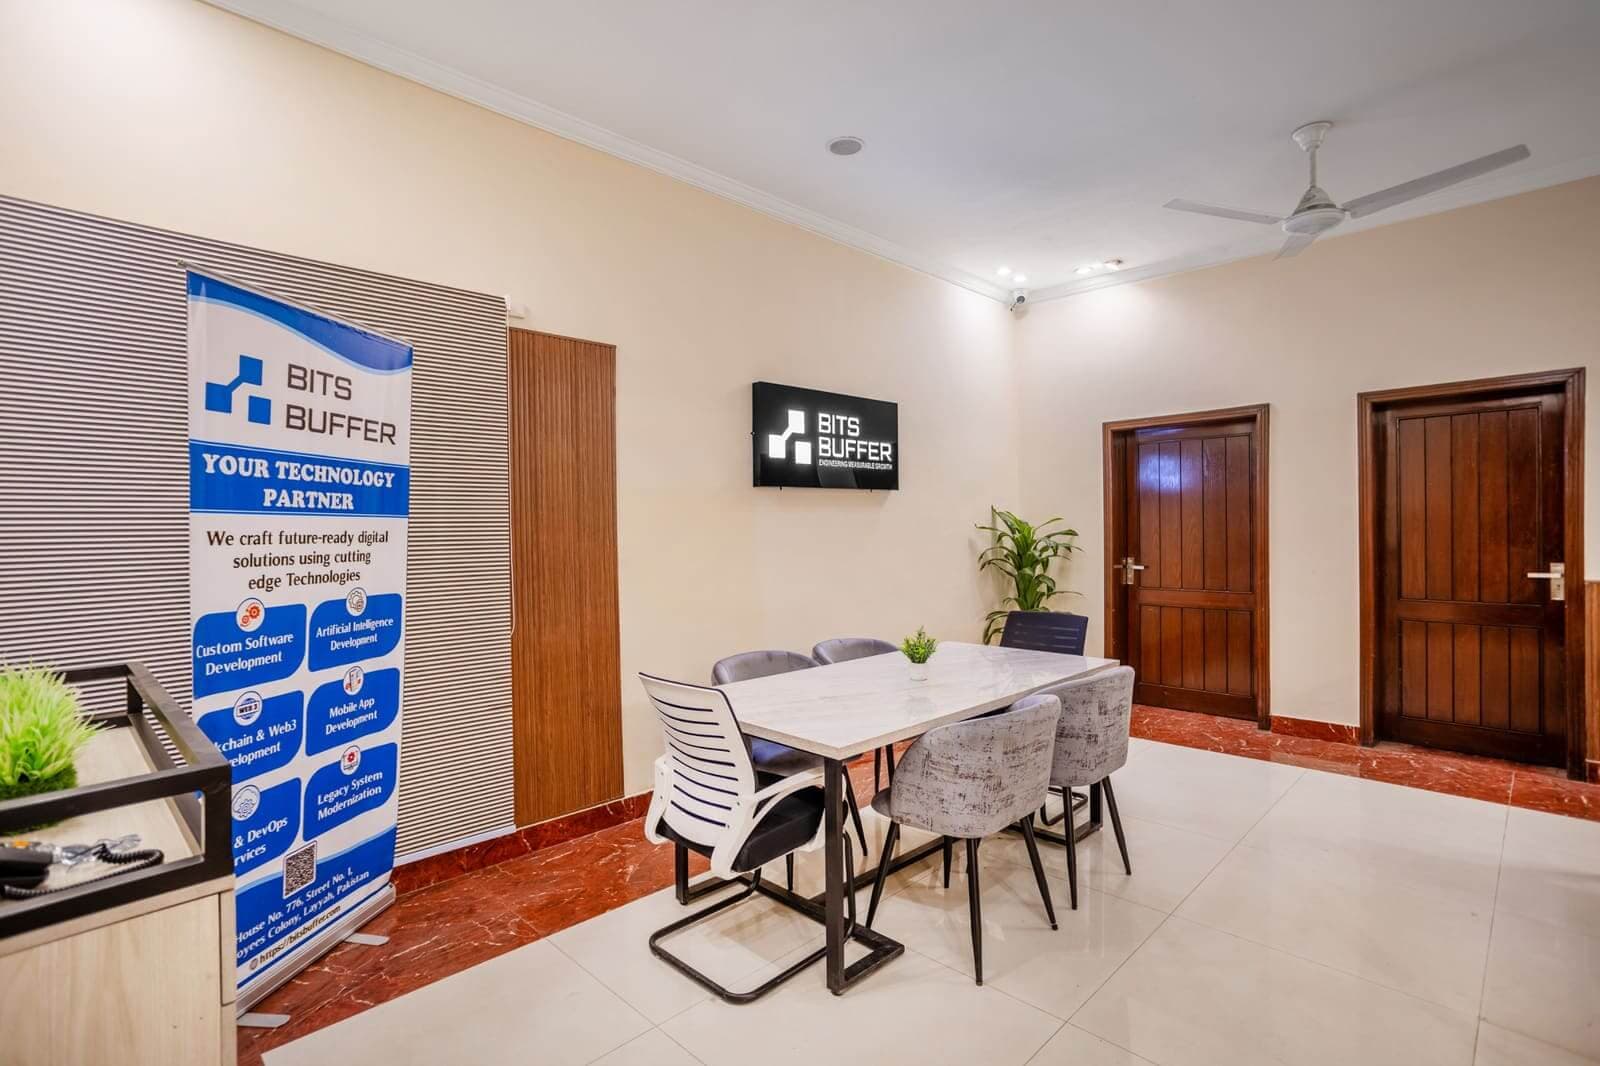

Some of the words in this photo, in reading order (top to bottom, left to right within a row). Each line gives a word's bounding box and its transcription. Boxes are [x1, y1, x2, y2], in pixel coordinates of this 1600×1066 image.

[287, 363, 352, 400] BITS
[286, 404, 396, 445] BUFFER
[818, 412, 860, 437] BITS
[818, 436, 892, 462] BUFFER
[202, 453, 269, 478] YOUR
[276, 461, 395, 488] TECHNOLOGY
[263, 488, 354, 510] PARTNER
[206, 531, 234, 546] We
[240, 530, 272, 546] craft
[278, 530, 354, 546] future-ready
[358, 530, 388, 544] digital
[233, 552, 294, 568] solutions
[300, 551, 330, 567] using
[334, 550, 370, 564] cutting
[248, 574, 282, 592] edge
[286, 570, 360, 586] Technologies
[316, 622, 351, 638] Artificial
[353, 617, 394, 632] Intelligence
[196, 640, 242, 658] Custom
[245, 632, 294, 650] Software
[330, 634, 378, 651] Development
[206, 652, 282, 676] Development
[329, 704, 357, 719] Mobile
[358, 697, 375, 710] App
[256, 729, 264, 742] &
[268, 719, 297, 738] Web3
[326, 710, 378, 736] Development
[318, 784, 349, 806] Legacy
[351, 771, 383, 792] System
[318, 786, 382, 821] Modernization
[234, 836, 244, 848] &
[248, 817, 288, 843] DevOps
[337, 872, 370, 895] Pakistan
[268, 911, 284, 925] No.
[306, 880, 330, 901] Street
